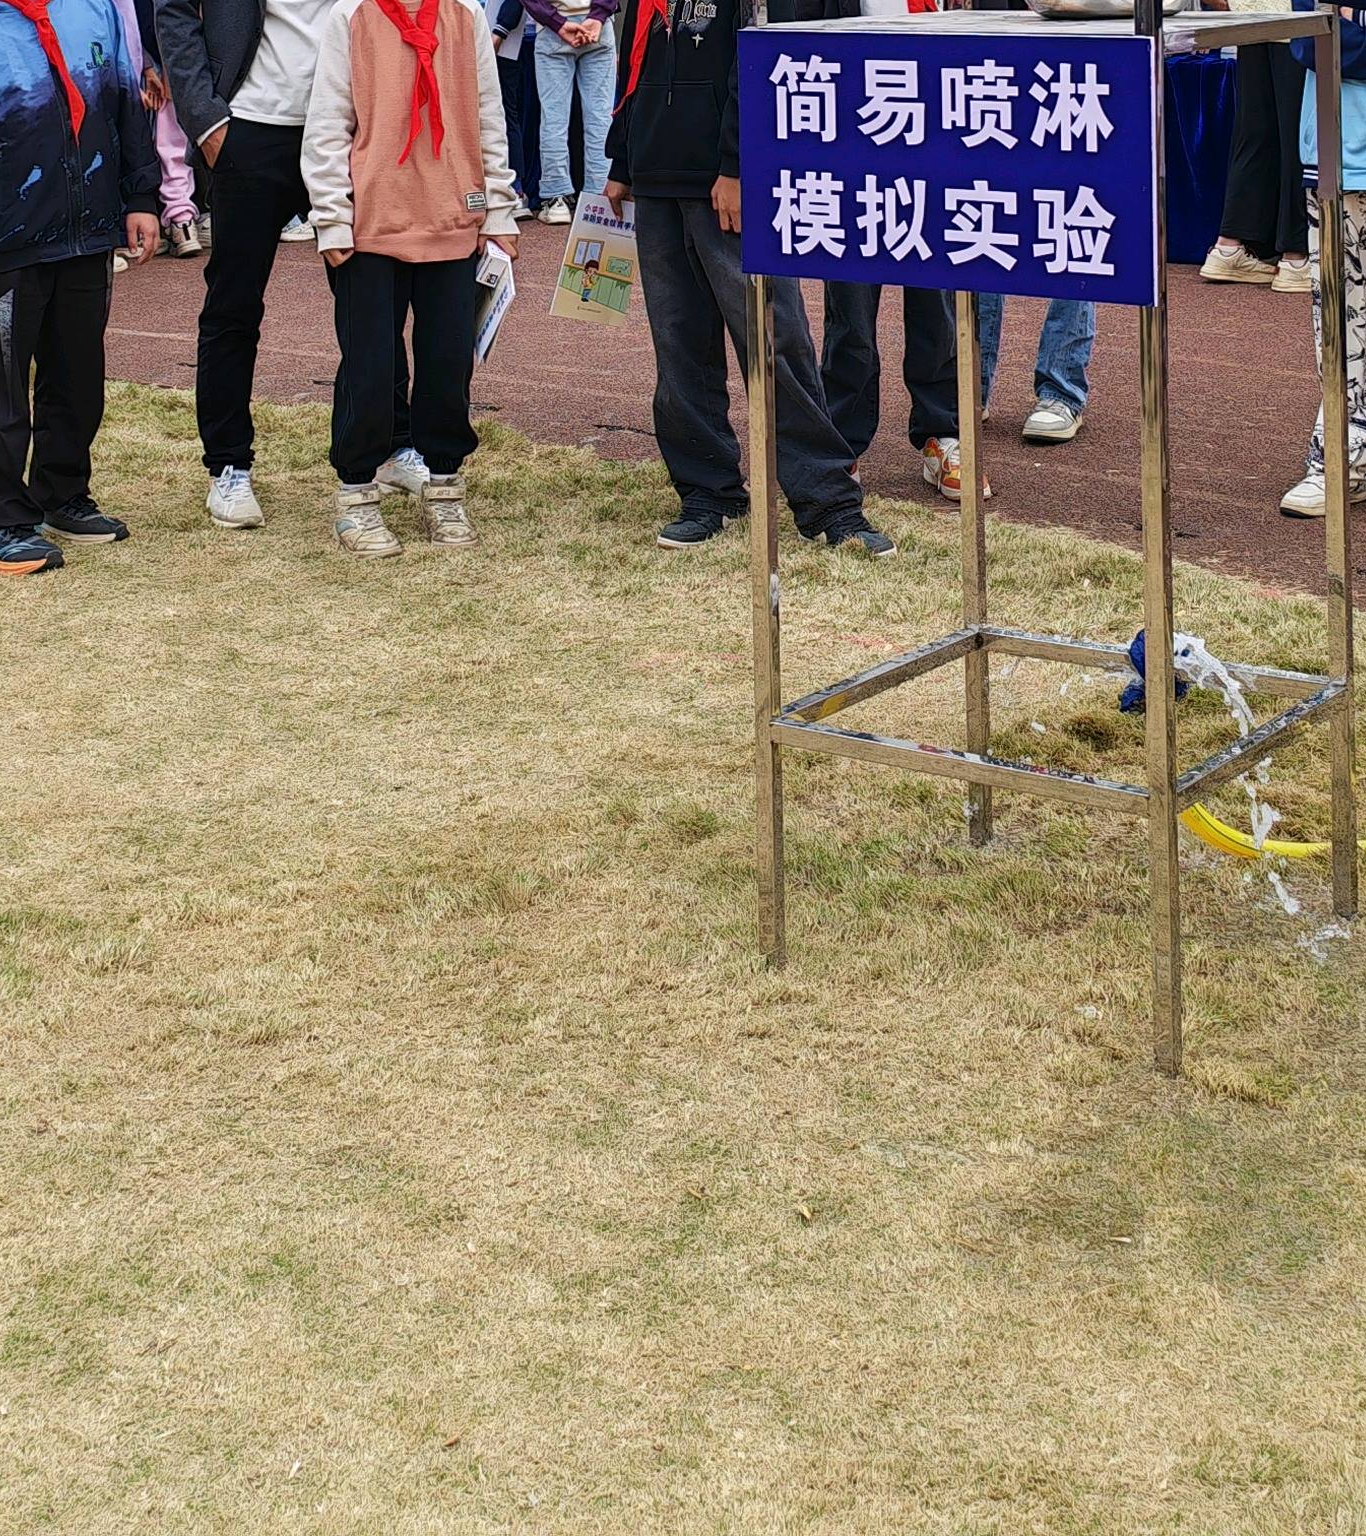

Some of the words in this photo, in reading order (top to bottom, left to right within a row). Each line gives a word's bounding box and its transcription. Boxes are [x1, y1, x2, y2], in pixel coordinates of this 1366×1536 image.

[769, 53, 1114, 153] 简易喷淋
[771, 169, 1117, 276] 模拟实验
